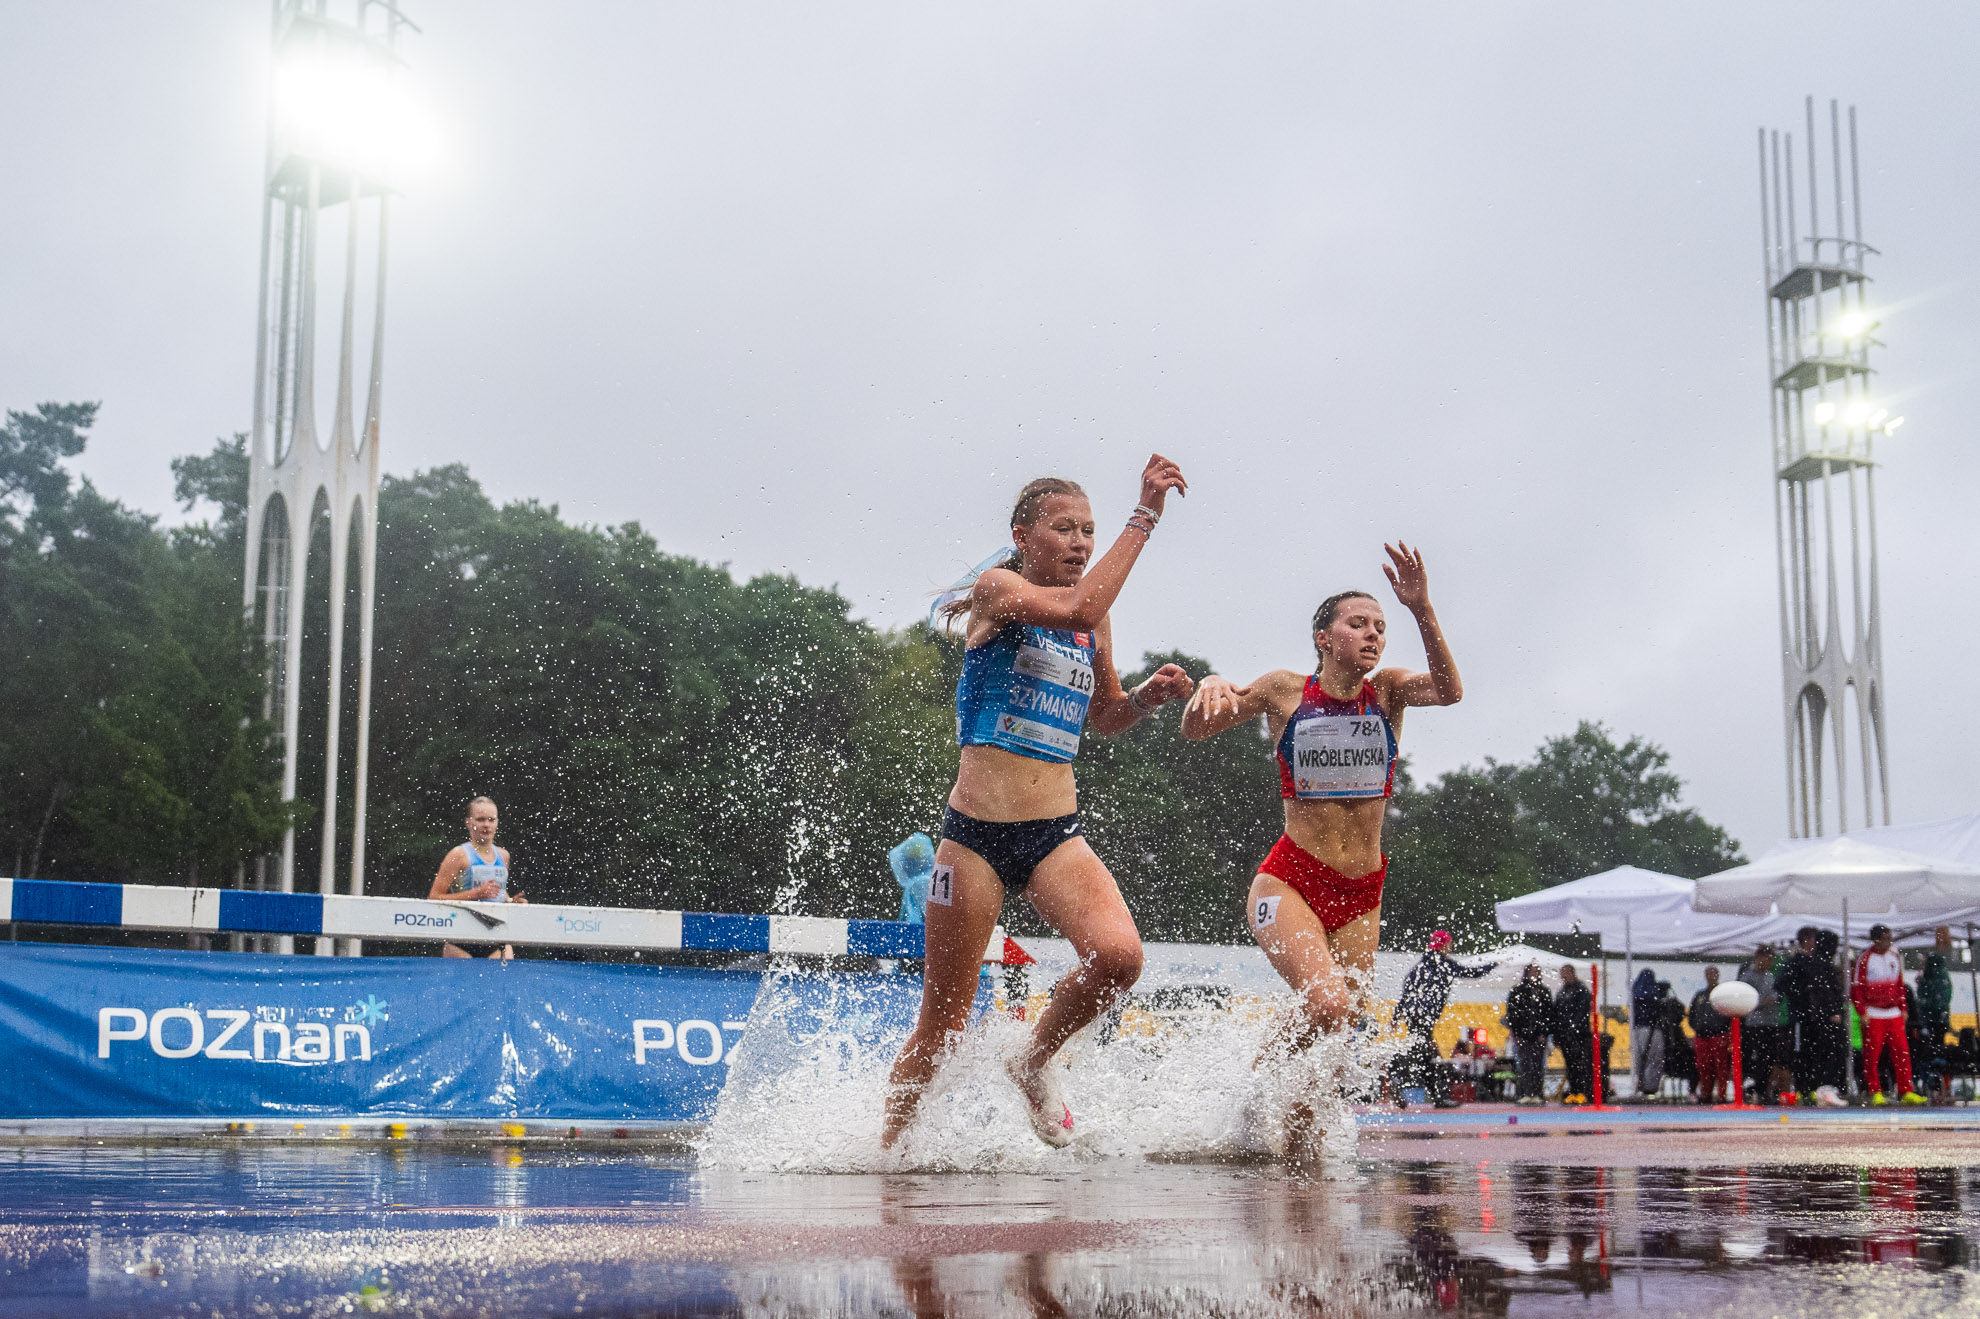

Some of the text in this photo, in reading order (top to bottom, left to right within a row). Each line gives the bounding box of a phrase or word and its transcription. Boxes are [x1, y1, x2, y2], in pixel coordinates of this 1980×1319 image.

[1036, 633, 1091, 666] VECTRA
[1069, 668, 1092, 692] 113
[1009, 684, 1085, 726] SZYMAŃSKA
[1350, 721, 1382, 737] 784
[1298, 745, 1385, 768] WRÓBLEWSKA
[931, 870, 950, 899] 11
[563, 919, 602, 935] posir
